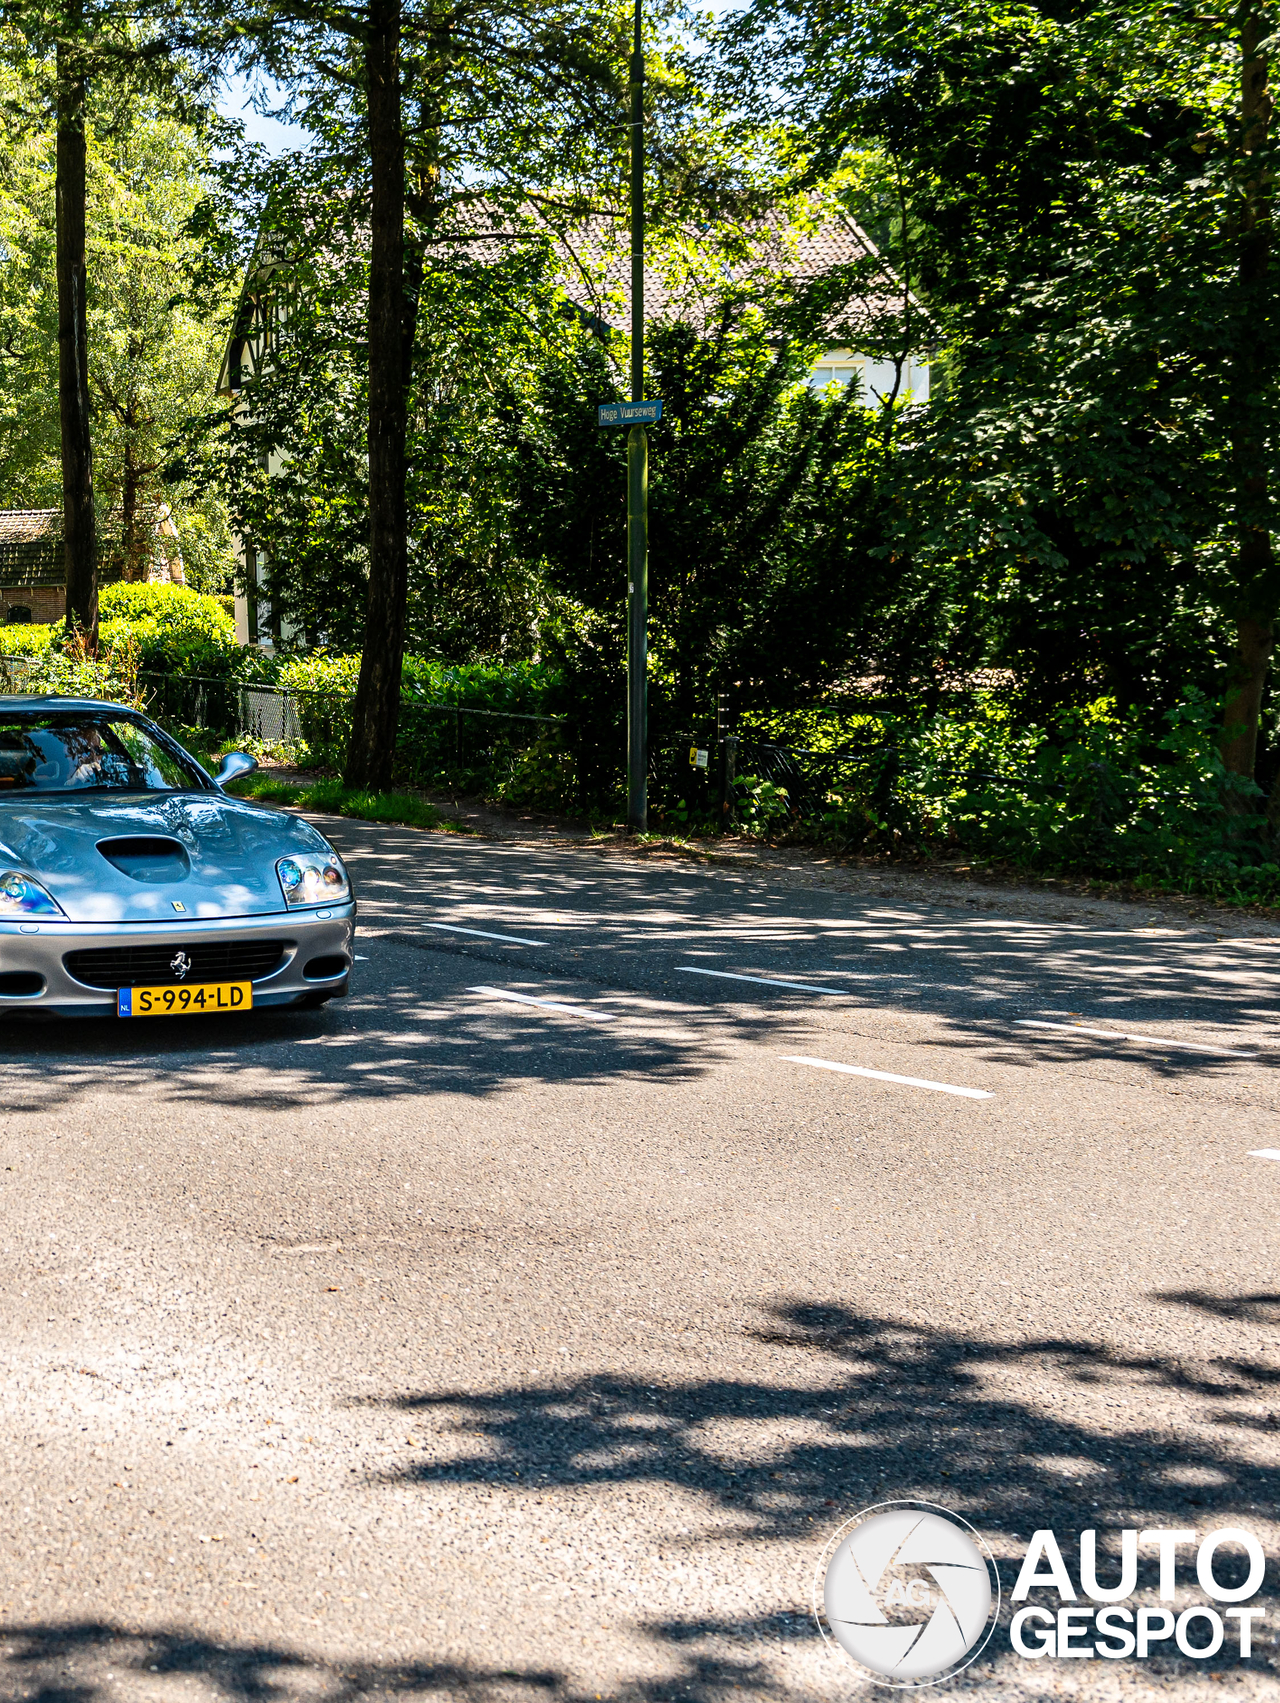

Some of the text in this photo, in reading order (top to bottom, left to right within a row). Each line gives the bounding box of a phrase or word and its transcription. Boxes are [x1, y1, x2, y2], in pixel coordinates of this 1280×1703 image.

[601, 406, 657, 422] Hoge Vuurseweg
[139, 986, 244, 1012] S-994-LD
